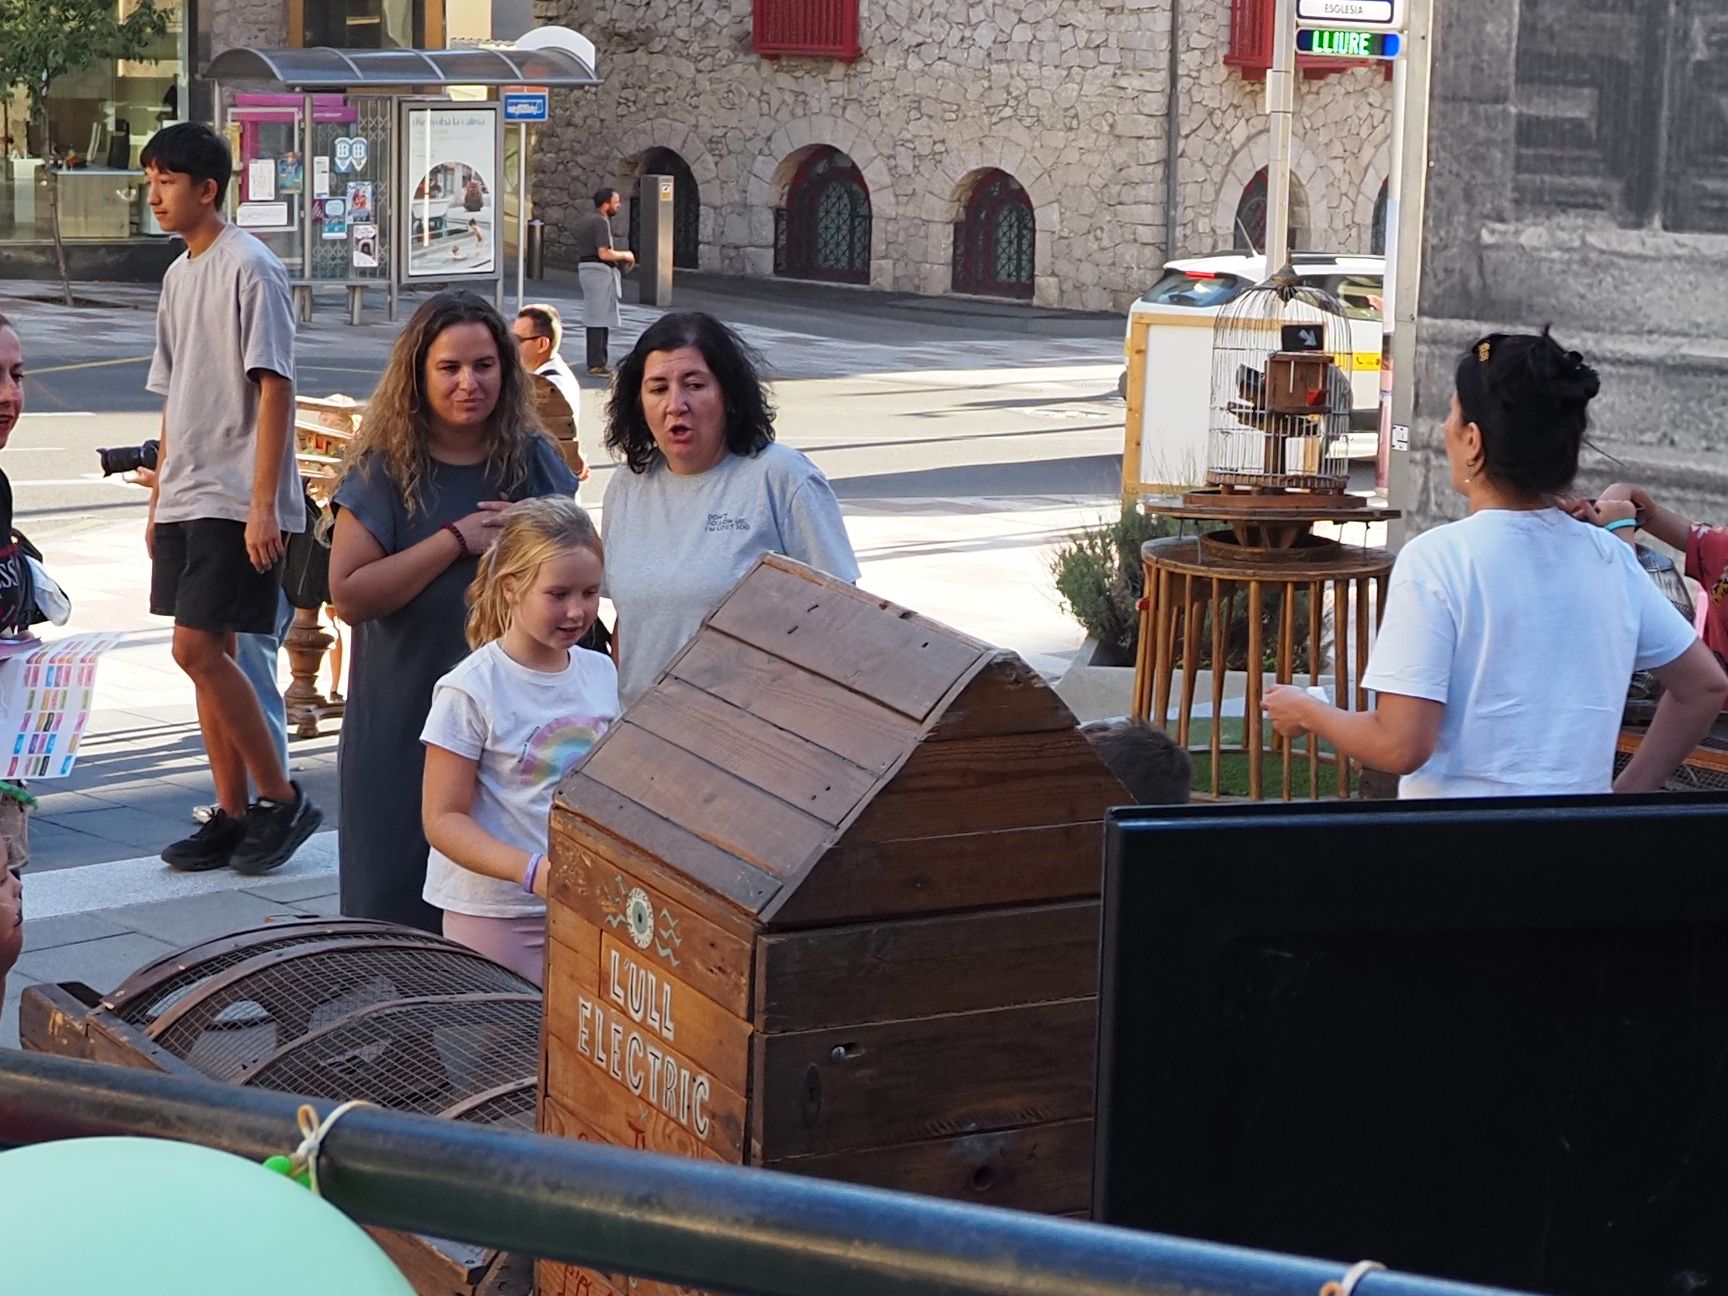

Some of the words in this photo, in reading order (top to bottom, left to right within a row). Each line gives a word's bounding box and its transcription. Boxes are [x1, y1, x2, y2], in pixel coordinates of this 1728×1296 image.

[1324, 3, 1364, 15] ESGLESIA
[1312, 30, 1372, 55] LLIURE
[609, 949, 675, 1041] L'ULL
[577, 995, 710, 1141] ELECTRIC
